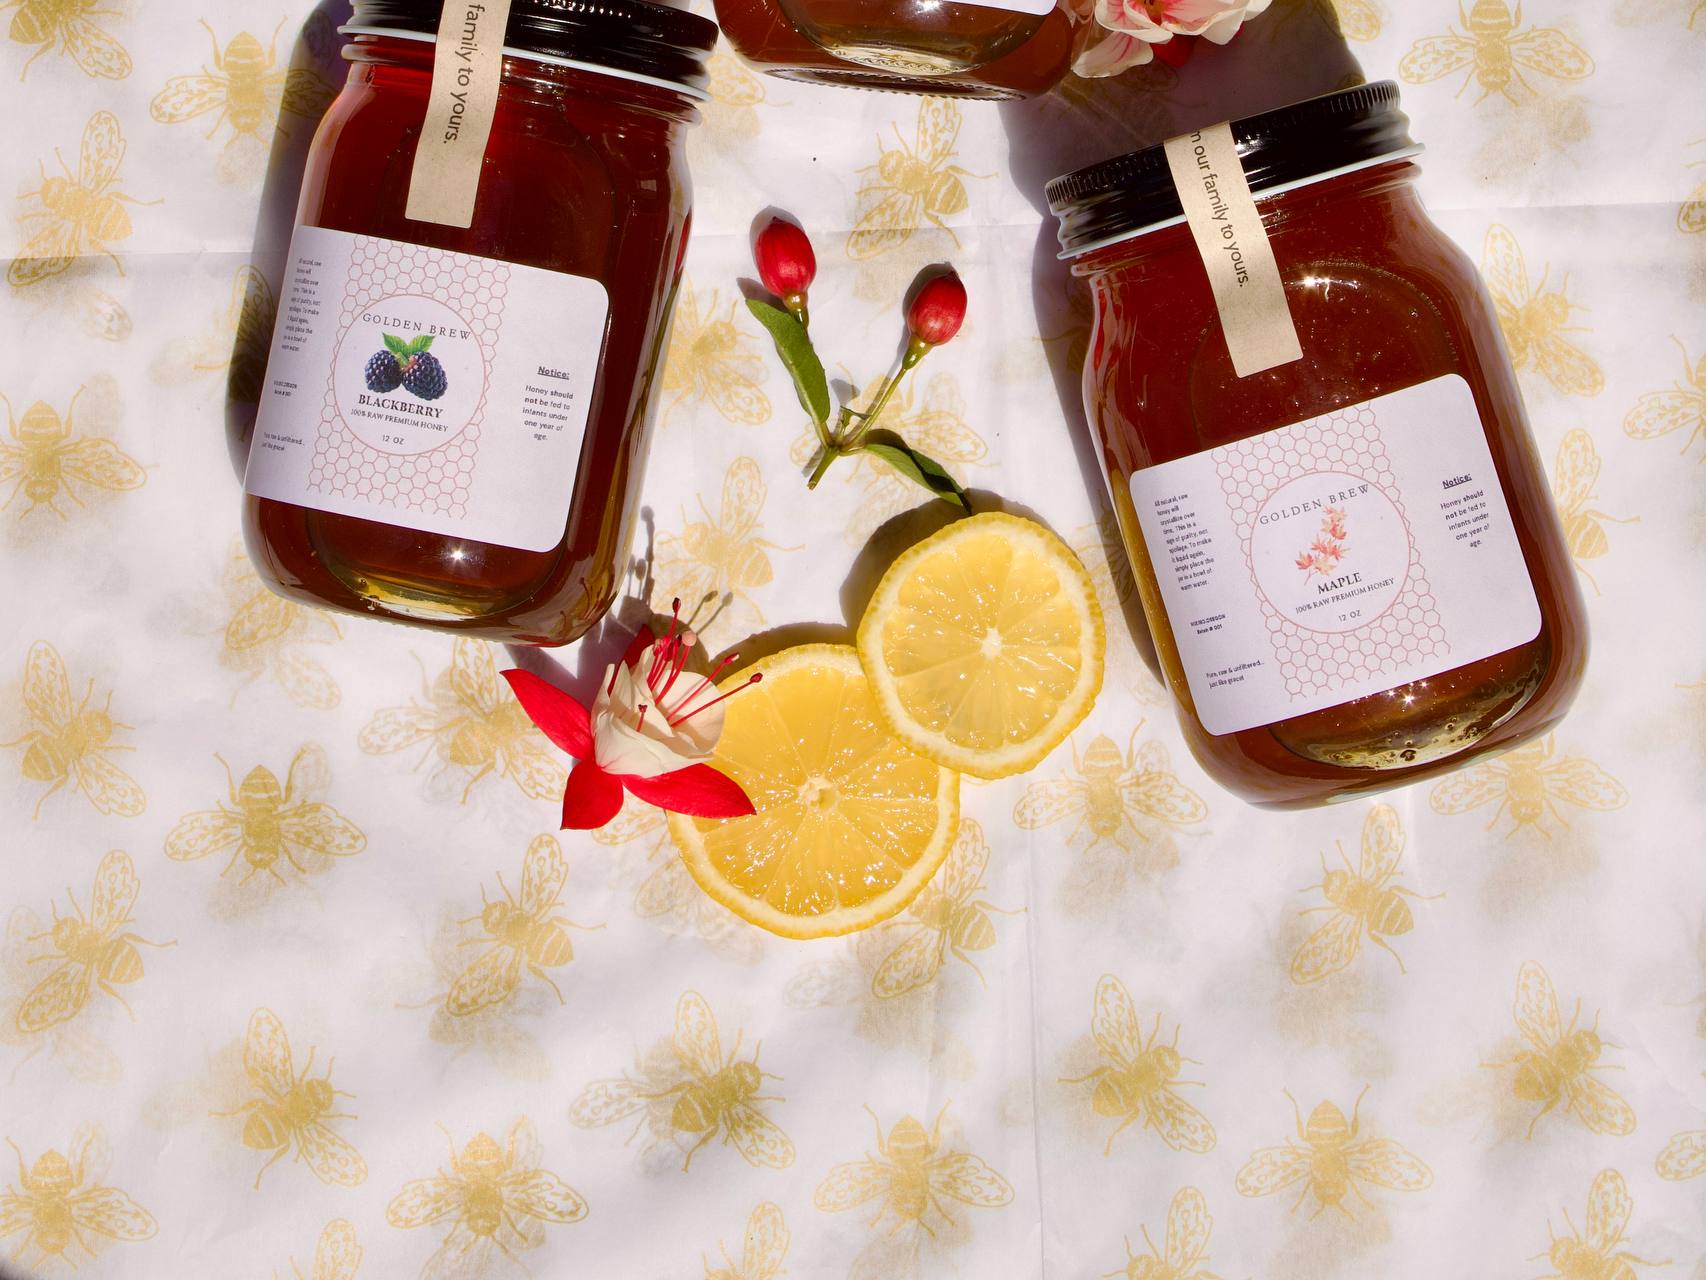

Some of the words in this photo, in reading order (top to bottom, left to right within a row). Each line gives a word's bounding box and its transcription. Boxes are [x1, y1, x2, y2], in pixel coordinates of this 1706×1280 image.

[455, 4, 485, 62] family
[457, 67, 473, 86] to
[443, 91, 468, 144] yours.
[1194, 146, 1211, 170] our
[1203, 173, 1230, 222] family
[1221, 224, 1233, 239] to
[1223, 241, 1248, 287] yours.
[362, 313, 422, 331] GOLDEN
[430, 325, 470, 340] BREW
[537, 366, 570, 380] Notice:
[525, 385, 548, 395] Honey
[550, 390, 573, 399] should
[358, 394, 443, 418] BLACKBERRY
[523, 408, 546, 417] infants
[385, 415, 419, 426] PREMIUM
[421, 422, 448, 432] HONEY
[393, 437, 404, 445] OZ
[1442, 473, 1472, 489] Notice:
[1260, 499, 1322, 525] GOLDEN
[1329, 484, 1369, 504] BREW
[1440, 499, 1461, 510] Honey
[1463, 490, 1484, 502] should
[1445, 512, 1457, 520] not
[1449, 520, 1471, 531] infants
[1472, 513, 1489, 522] under
[1456, 532, 1468, 540] one
[1469, 527, 1482, 536] year
[1318, 572, 1362, 594] MAPLE
[1296, 604, 1312, 614] 100%
[1313, 599, 1330, 609] RAW
[1332, 587, 1367, 603] PREMIUM
[1367, 577, 1395, 592] HONEY
[1338, 614, 1346, 622] 12
[1350, 610, 1361, 618] OZ
